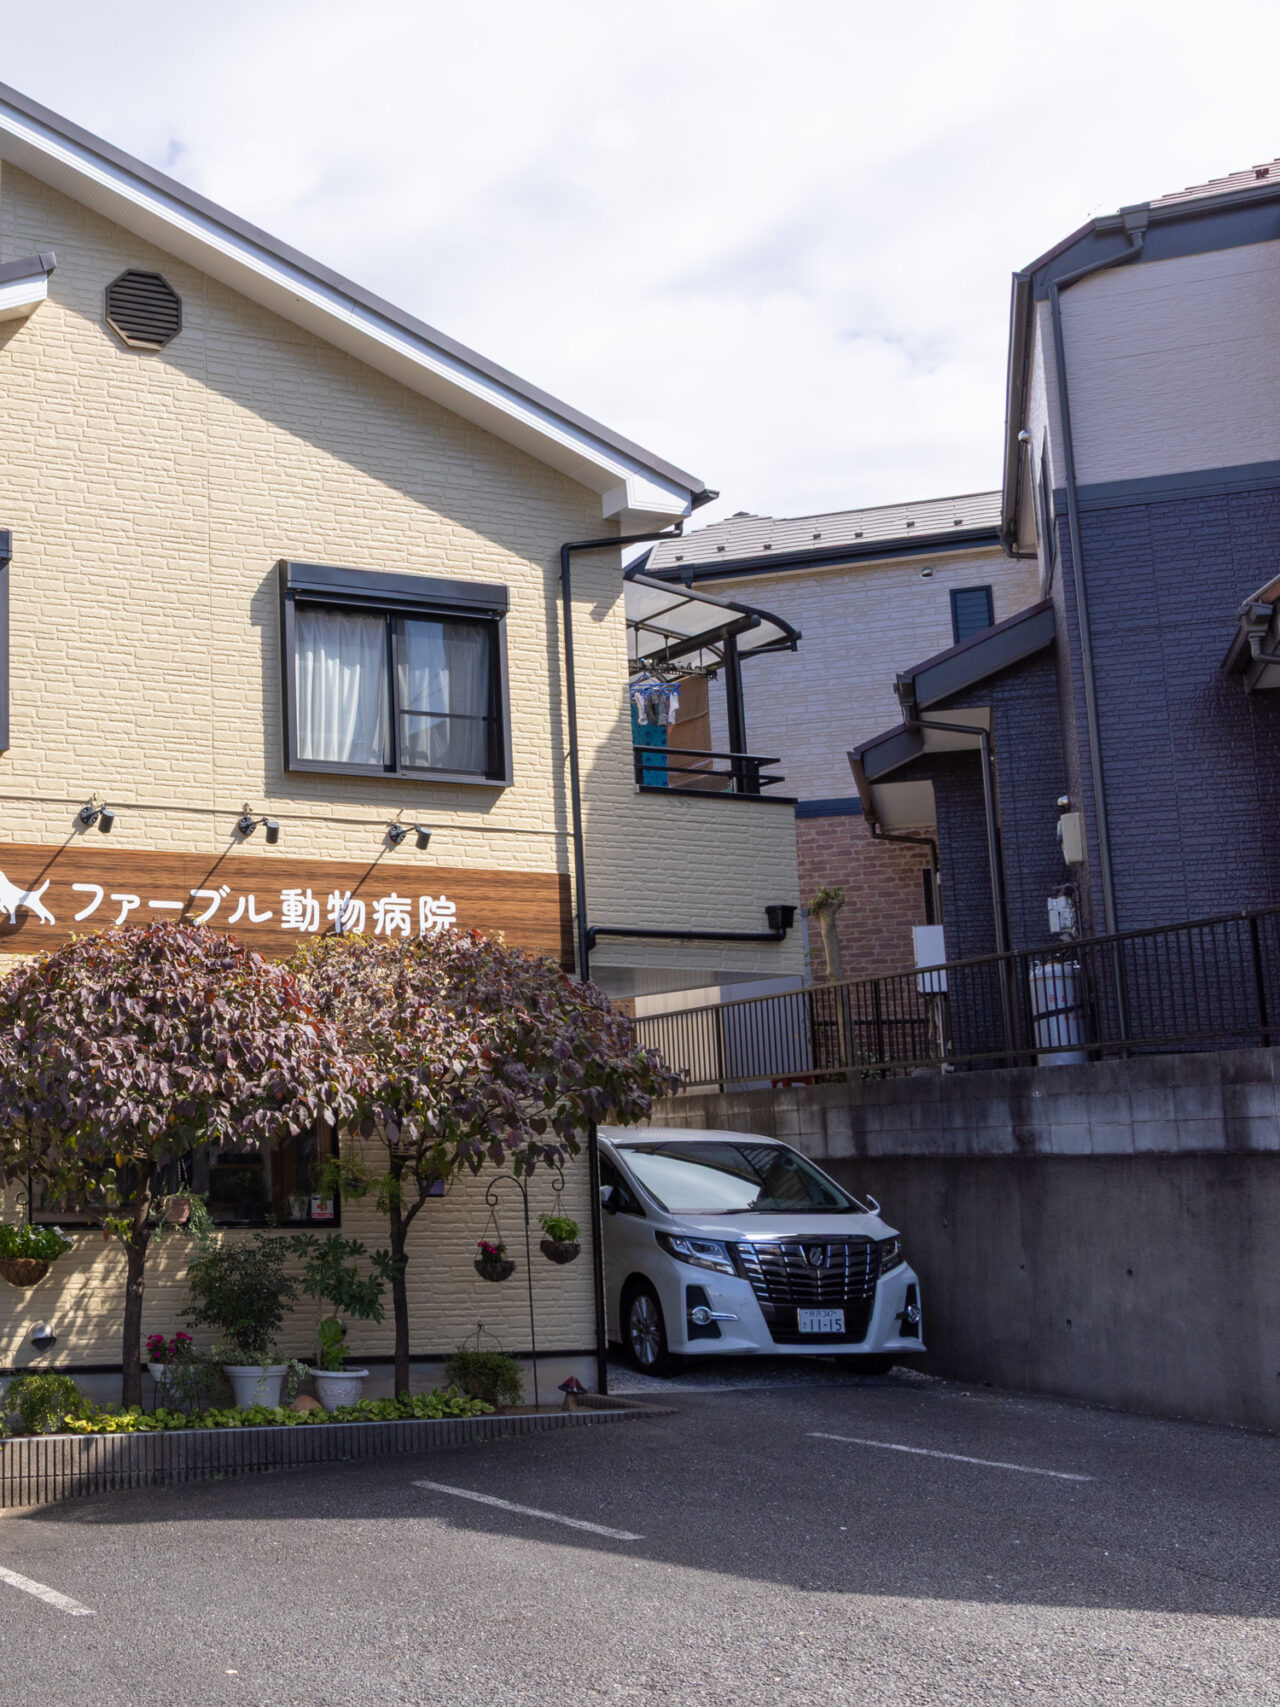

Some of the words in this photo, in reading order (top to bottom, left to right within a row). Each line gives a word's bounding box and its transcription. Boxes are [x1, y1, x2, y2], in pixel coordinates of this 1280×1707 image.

[72, 883, 457, 937] ファーブル動物病院
